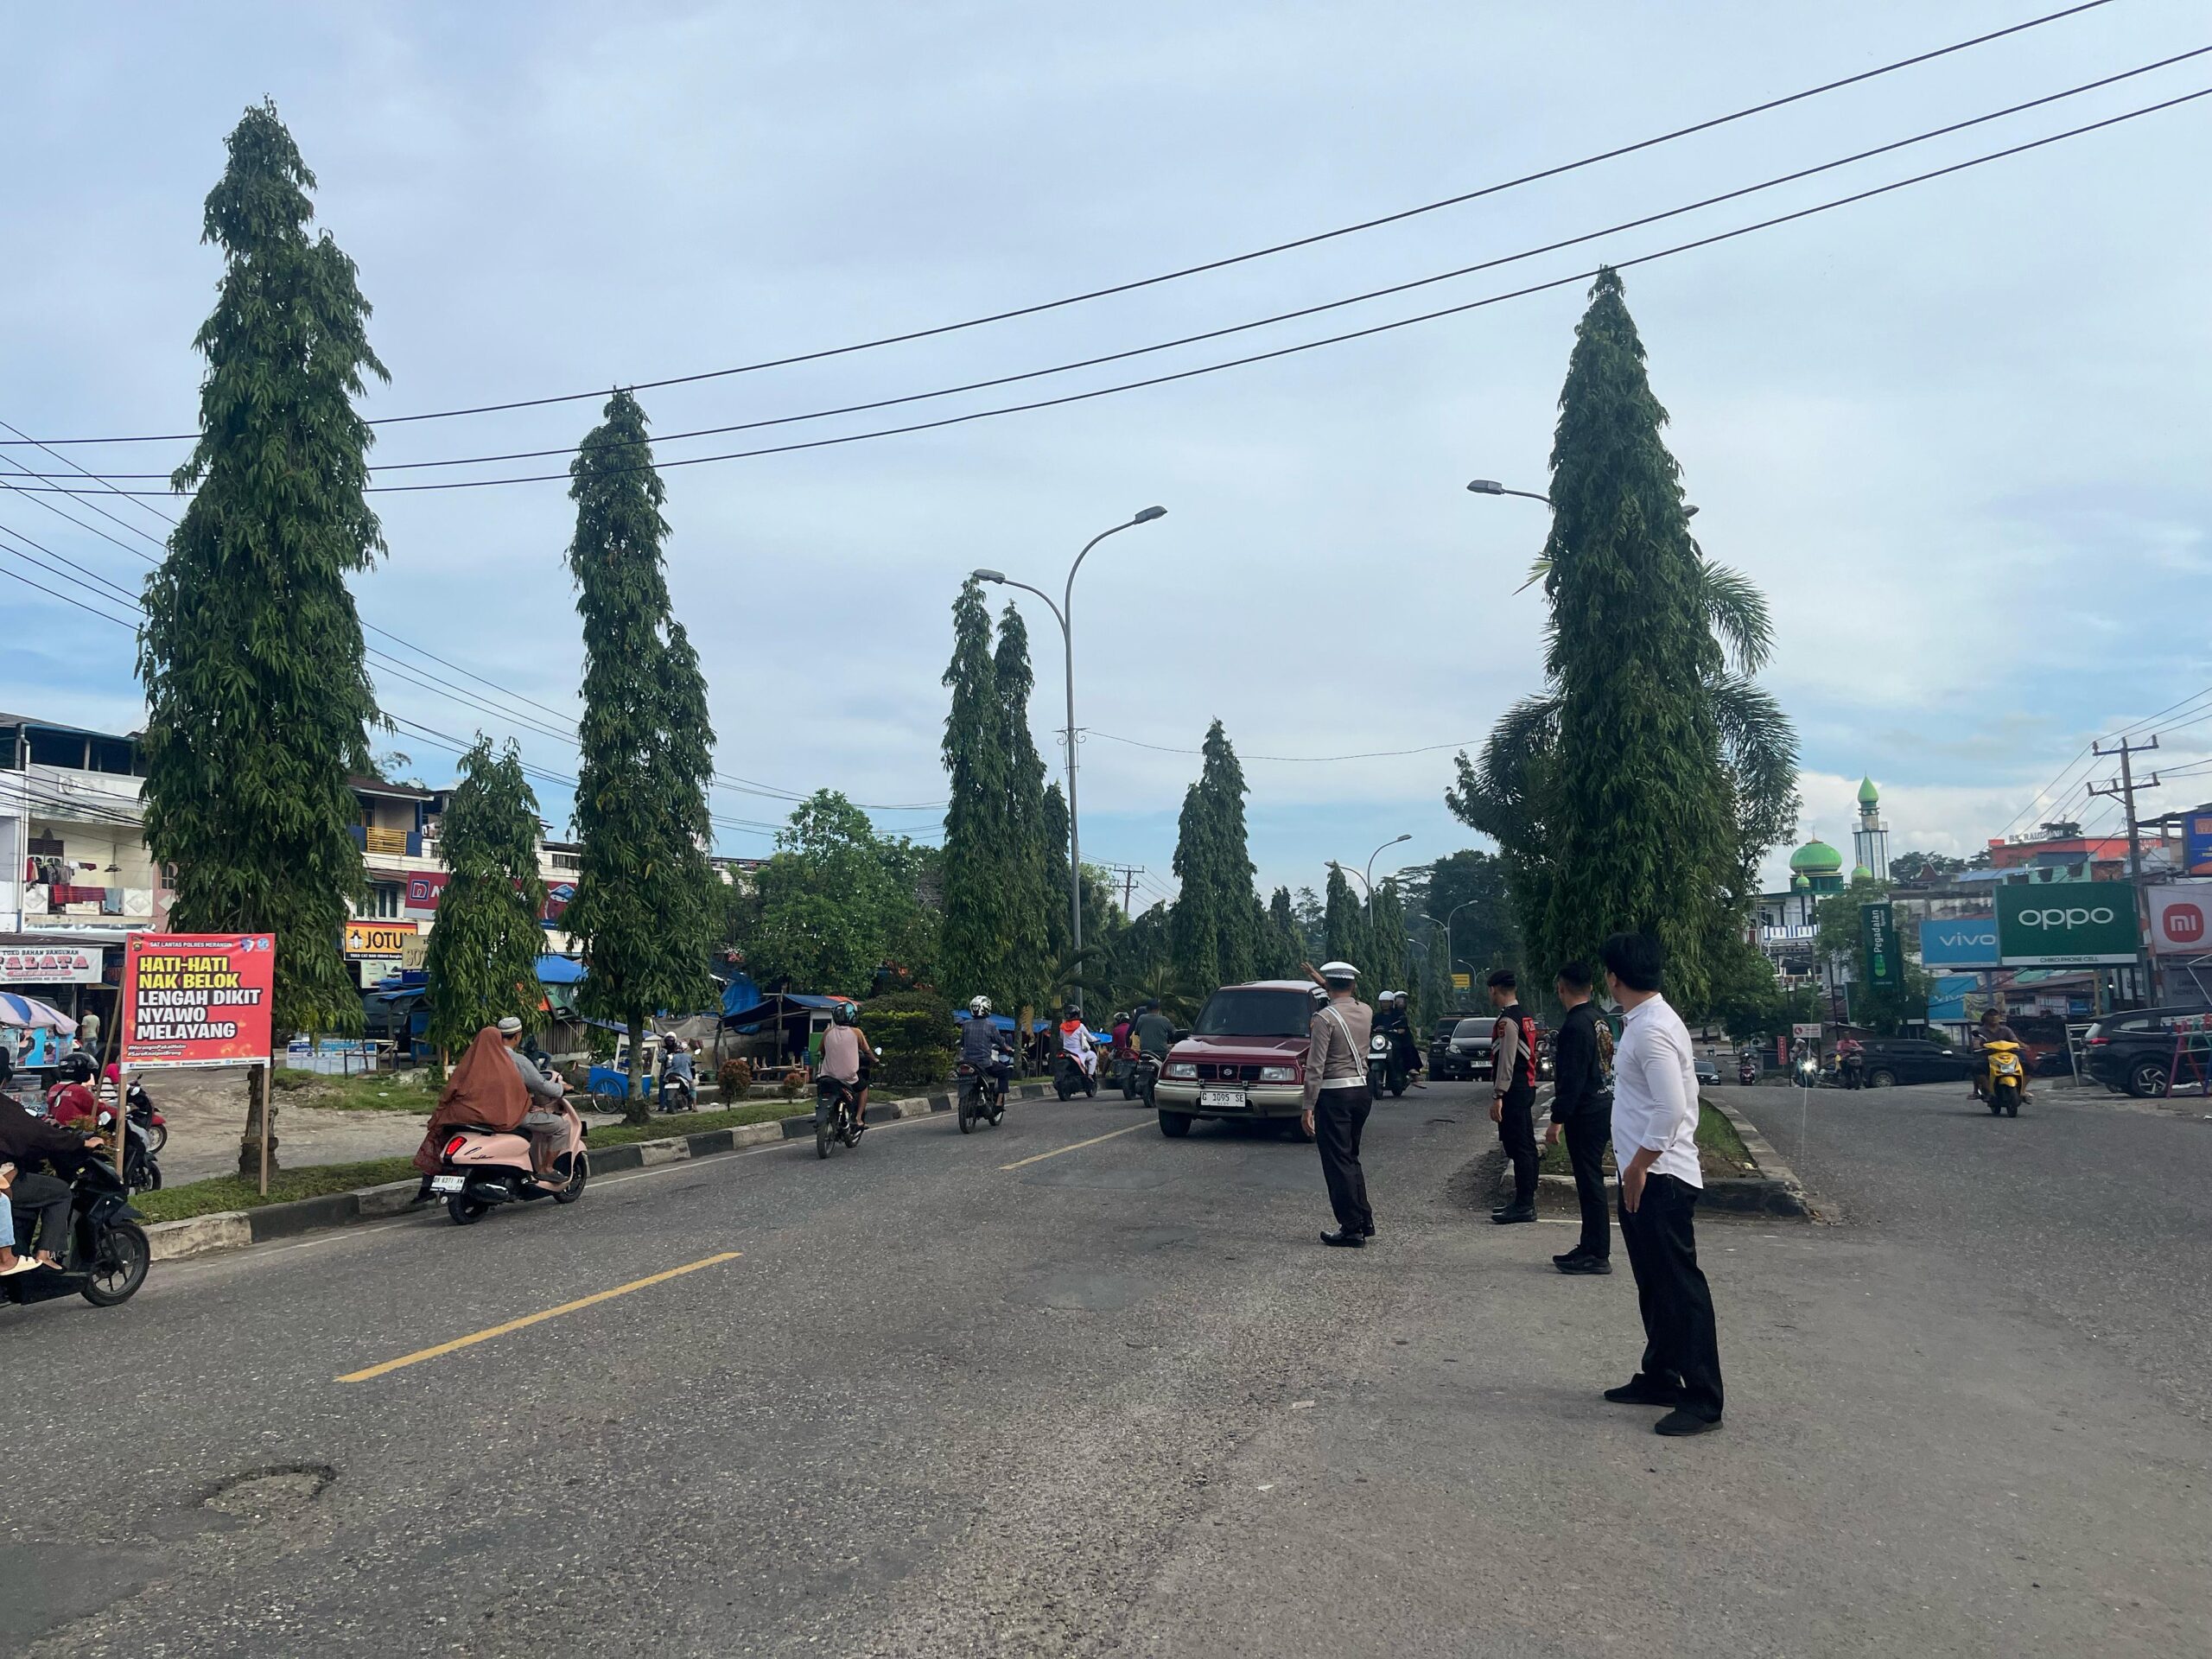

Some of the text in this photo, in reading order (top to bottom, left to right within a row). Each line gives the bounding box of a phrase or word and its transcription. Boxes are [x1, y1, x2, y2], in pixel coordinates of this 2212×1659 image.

[2018, 907, 2114, 931] oppo
[1871, 909, 1884, 953] Pegadaian
[1939, 932, 1996, 946] vivo
[365, 931, 415, 950] JOTU
[139, 957, 228, 972] HATI-HATI
[139, 974, 179, 989] NAK
[183, 973, 238, 988] BELOK
[138, 989, 261, 1006] LENGAH DIKIT
[137, 1007, 207, 1023] NYAWO
[137, 1022, 236, 1040] MELAYANG
[1202, 1092, 1244, 1103] G 1095 SE
